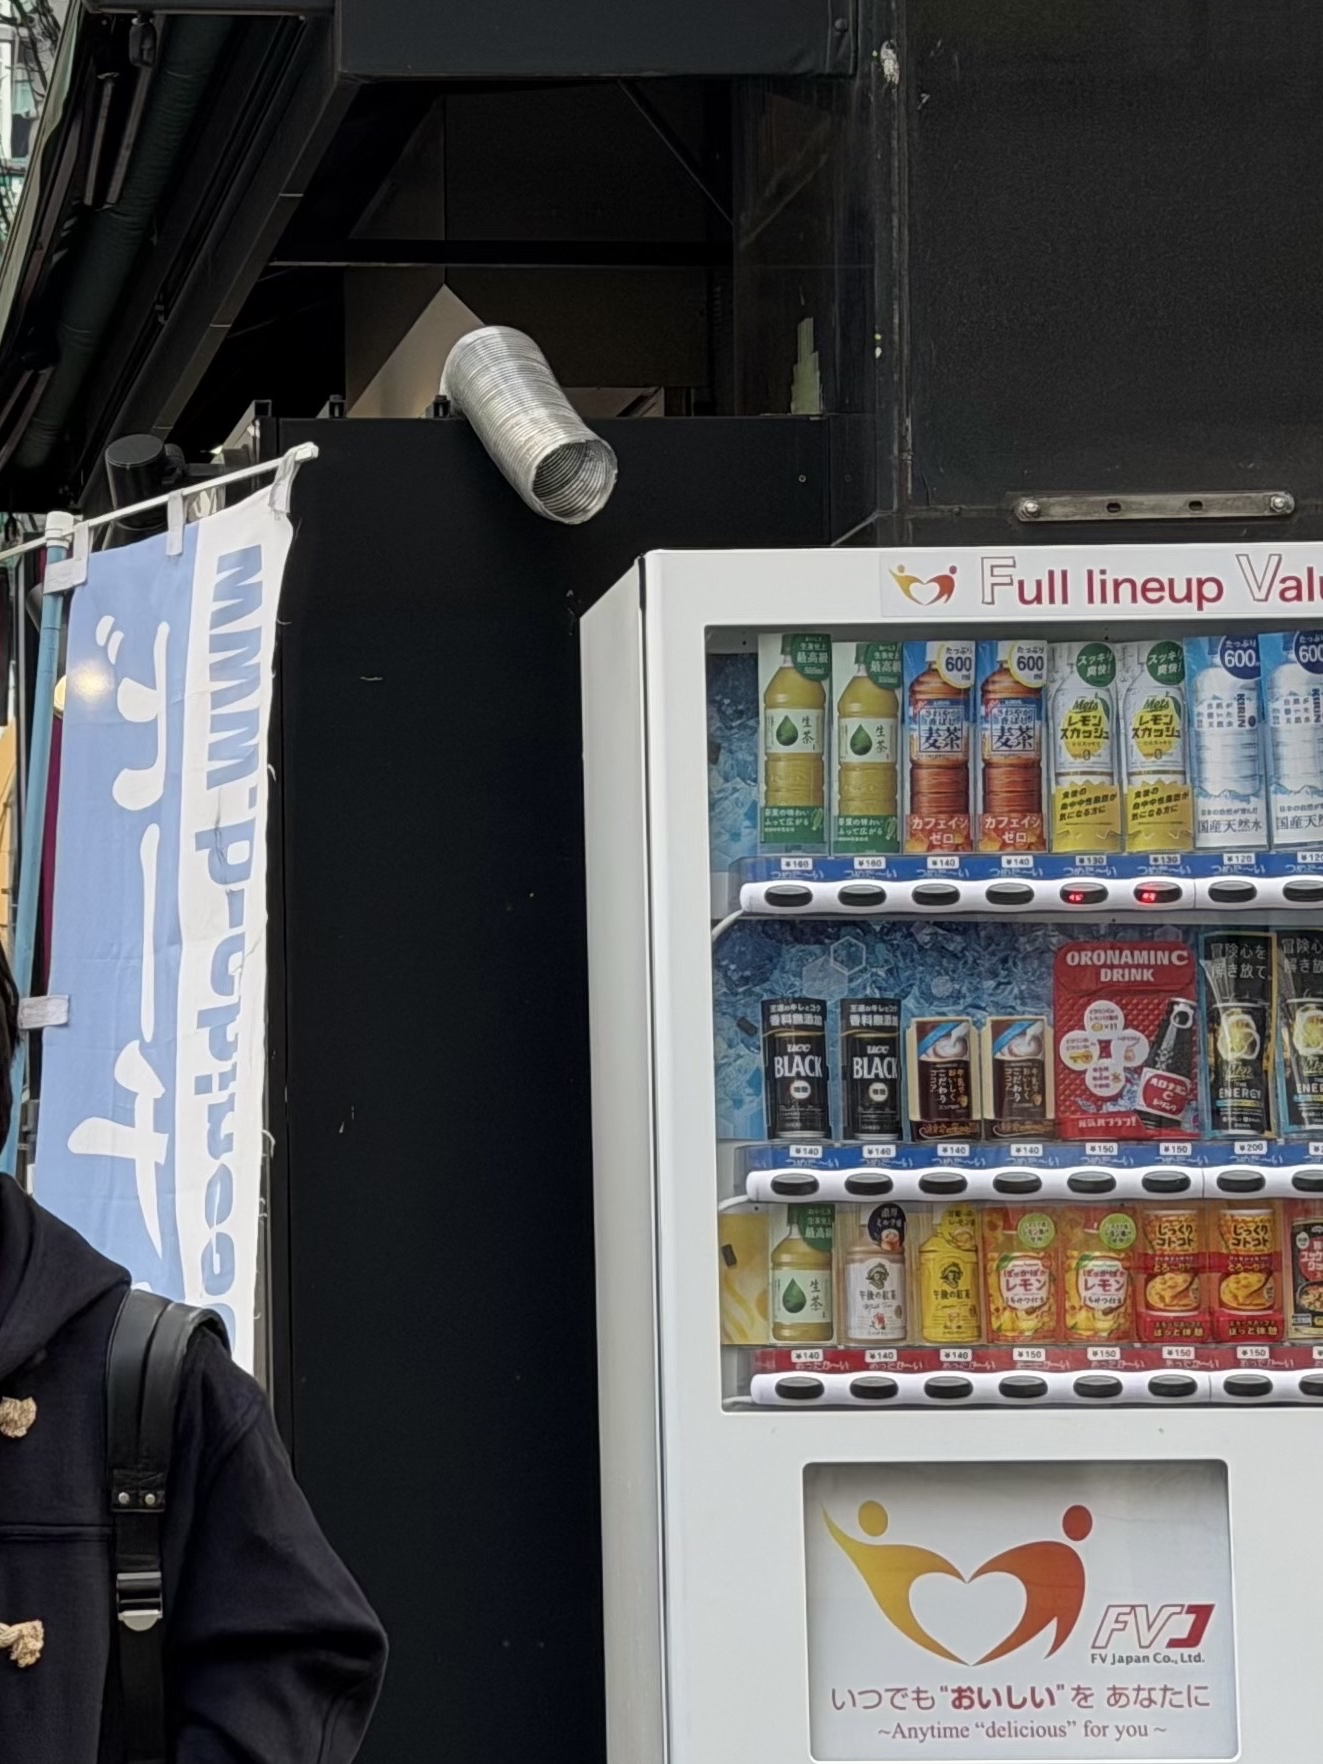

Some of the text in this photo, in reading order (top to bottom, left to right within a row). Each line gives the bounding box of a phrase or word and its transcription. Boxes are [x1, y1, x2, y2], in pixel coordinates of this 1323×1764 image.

[981, 556, 1069, 605] Full
[1087, 569, 1224, 611] lineup
[946, 646, 973, 655] たっぷり
[1017, 646, 1045, 655] たっぷり
[945, 656, 973, 672] 600
[1017, 655, 1045, 672] 600
[1224, 649, 1256, 668] 600
[1072, 699, 1099, 711] Mets
[1143, 698, 1170, 711] Mets
[1236, 693, 1247, 728] KIRIN
[1068, 715, 1103, 727] レモン
[1138, 714, 1174, 726] レモン
[801, 715, 815, 744] 生茶
[1060, 727, 1110, 740] スカッシュ
[1131, 727, 1182, 739] スカッシュ
[875, 724, 888, 753] 生茶
[922, 726, 962, 750] 麦茶
[994, 725, 1034, 749] 麦茶
[912, 816, 969, 830] カフェイン
[984, 815, 1041, 829] カフェイン
[1197, 818, 1262, 834] 国産天然水
[929, 832, 954, 845] ゼロ
[1002, 832, 1027, 844] ゼロ
[1210, 942, 1267, 960] 冒険心を
[1100, 968, 1155, 982] DRINK
[769, 1014, 823, 1027] 香料無添加
[786, 1044, 812, 1053] UCC
[866, 1045, 890, 1054] UCC
[774, 1055, 823, 1079] BLACK
[853, 1056, 898, 1079] BLACK
[1218, 1087, 1262, 1099] ENERGY
[1090, 1145, 1115, 1153] ¥150
[1164, 1145, 1188, 1153] ¥150
[1158, 1224, 1194, 1237] じっくり
[1233, 1224, 1269, 1236] じっくり
[1156, 1237, 1195, 1248] コトコト
[1231, 1237, 1269, 1248] コトコト
[1005, 1278, 1047, 1293] レモン
[1084, 1278, 1125, 1293] レモン
[809, 1279, 824, 1312] 生茶
[859, 1290, 897, 1301] 午後の紅茶
[794, 1351, 819, 1360] ¥140
[869, 1351, 894, 1360] ¥140
[1017, 1350, 1042, 1359] ¥150
[1091, 1350, 1116, 1358] ¥150
[1091, 1603, 1216, 1649] FVJ
[1091, 1652, 1108, 1664] FV
[1110, 1652, 1151, 1666] Japan
[1180, 1652, 1206, 1664] Ltd.
[1106, 1685, 1211, 1709] あなたに
[1083, 1719, 1110, 1738] for
[1114, 1725, 1149, 1743] you
